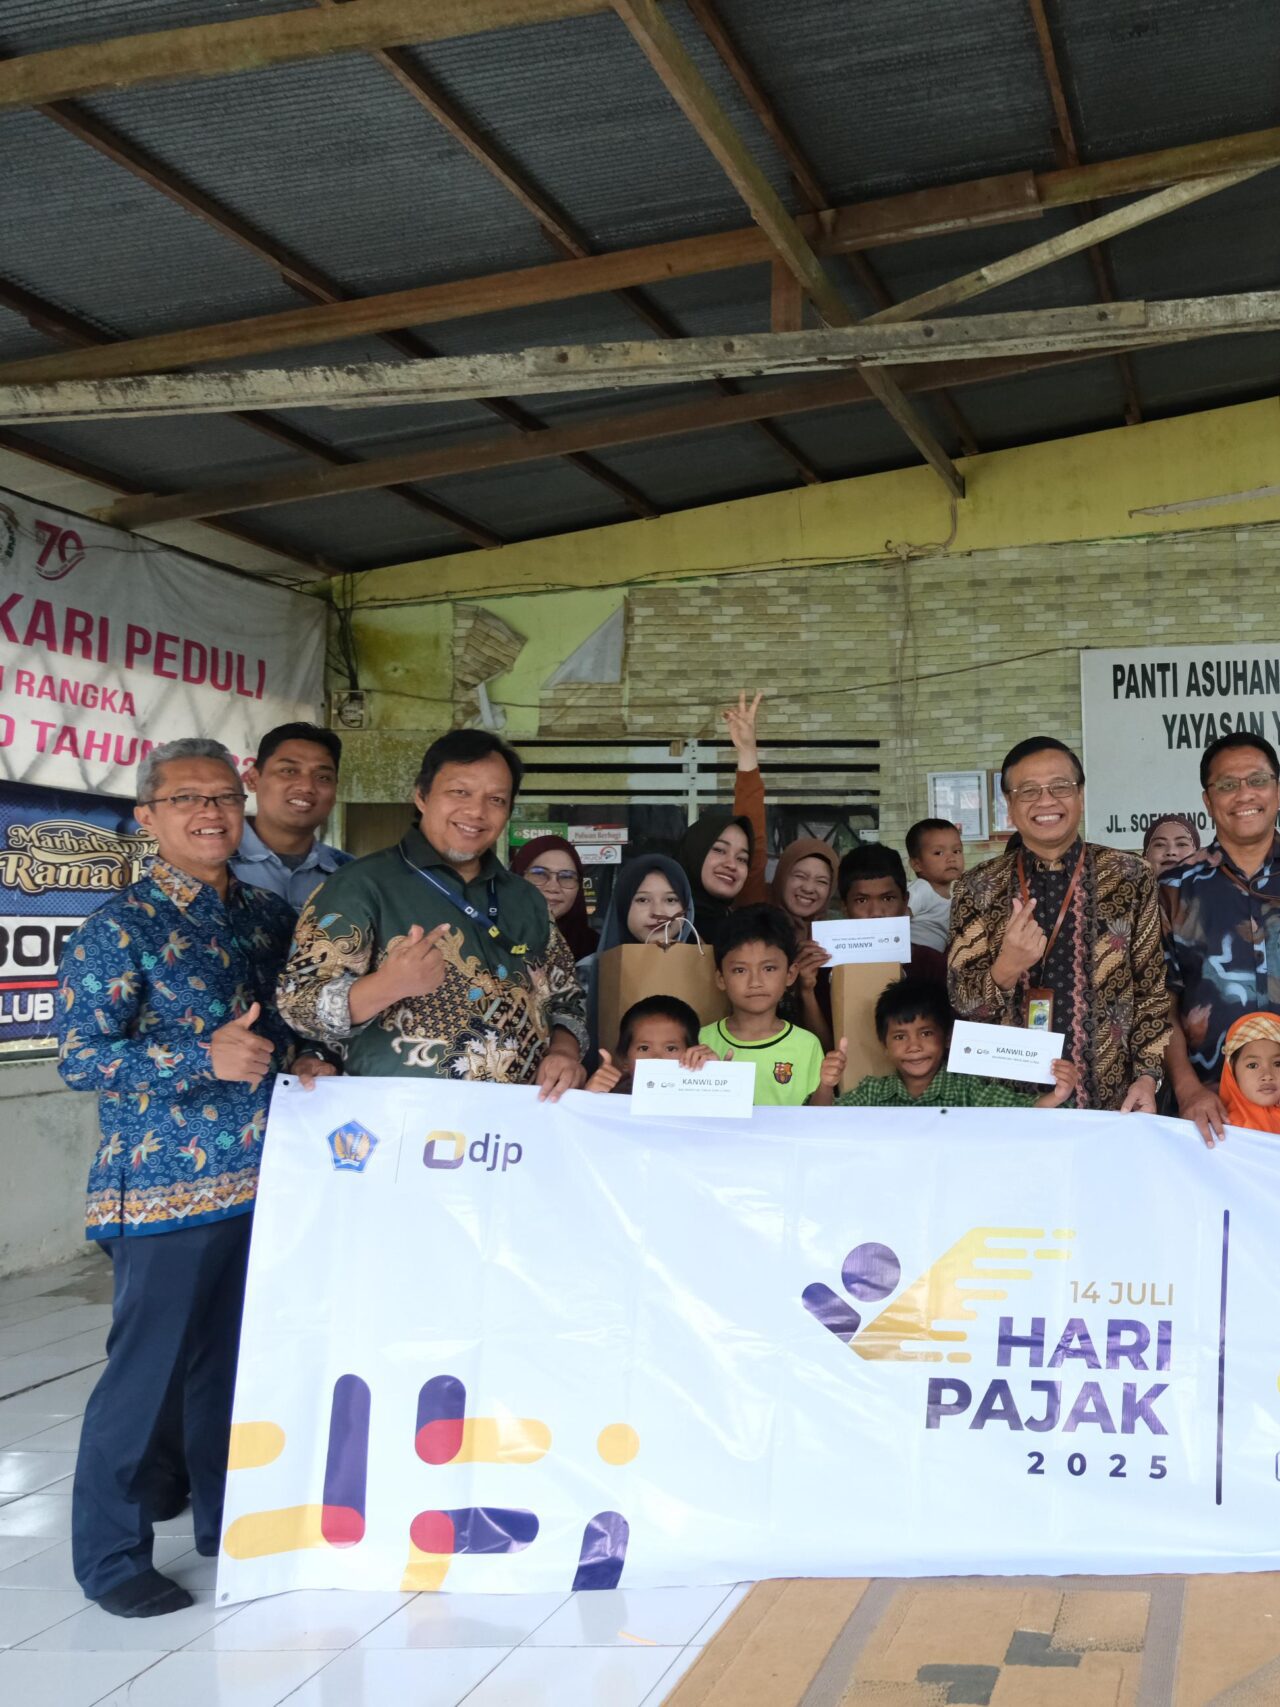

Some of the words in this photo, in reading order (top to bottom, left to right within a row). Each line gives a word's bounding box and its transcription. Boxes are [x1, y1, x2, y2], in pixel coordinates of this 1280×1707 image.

[124, 623, 266, 700] PEDULI
[1112, 661, 1179, 699] PANTI
[1186, 659, 1280, 697] ASUHAN
[15, 669, 137, 717] RANGKA
[1162, 711, 1265, 750] YAYASAN
[1106, 814, 1127, 834] JL.
[1130, 812, 1207, 833] SONO
[996, 1047, 1024, 1056] KANWIL
[682, 1078, 713, 1086] KANWIL
[468, 1132, 523, 1172] djp
[1069, 1281, 1101, 1305] 14
[1109, 1282, 1174, 1306] JULI
[996, 1316, 1173, 1371] HARI
[925, 1376, 1170, 1436] PAJAK
